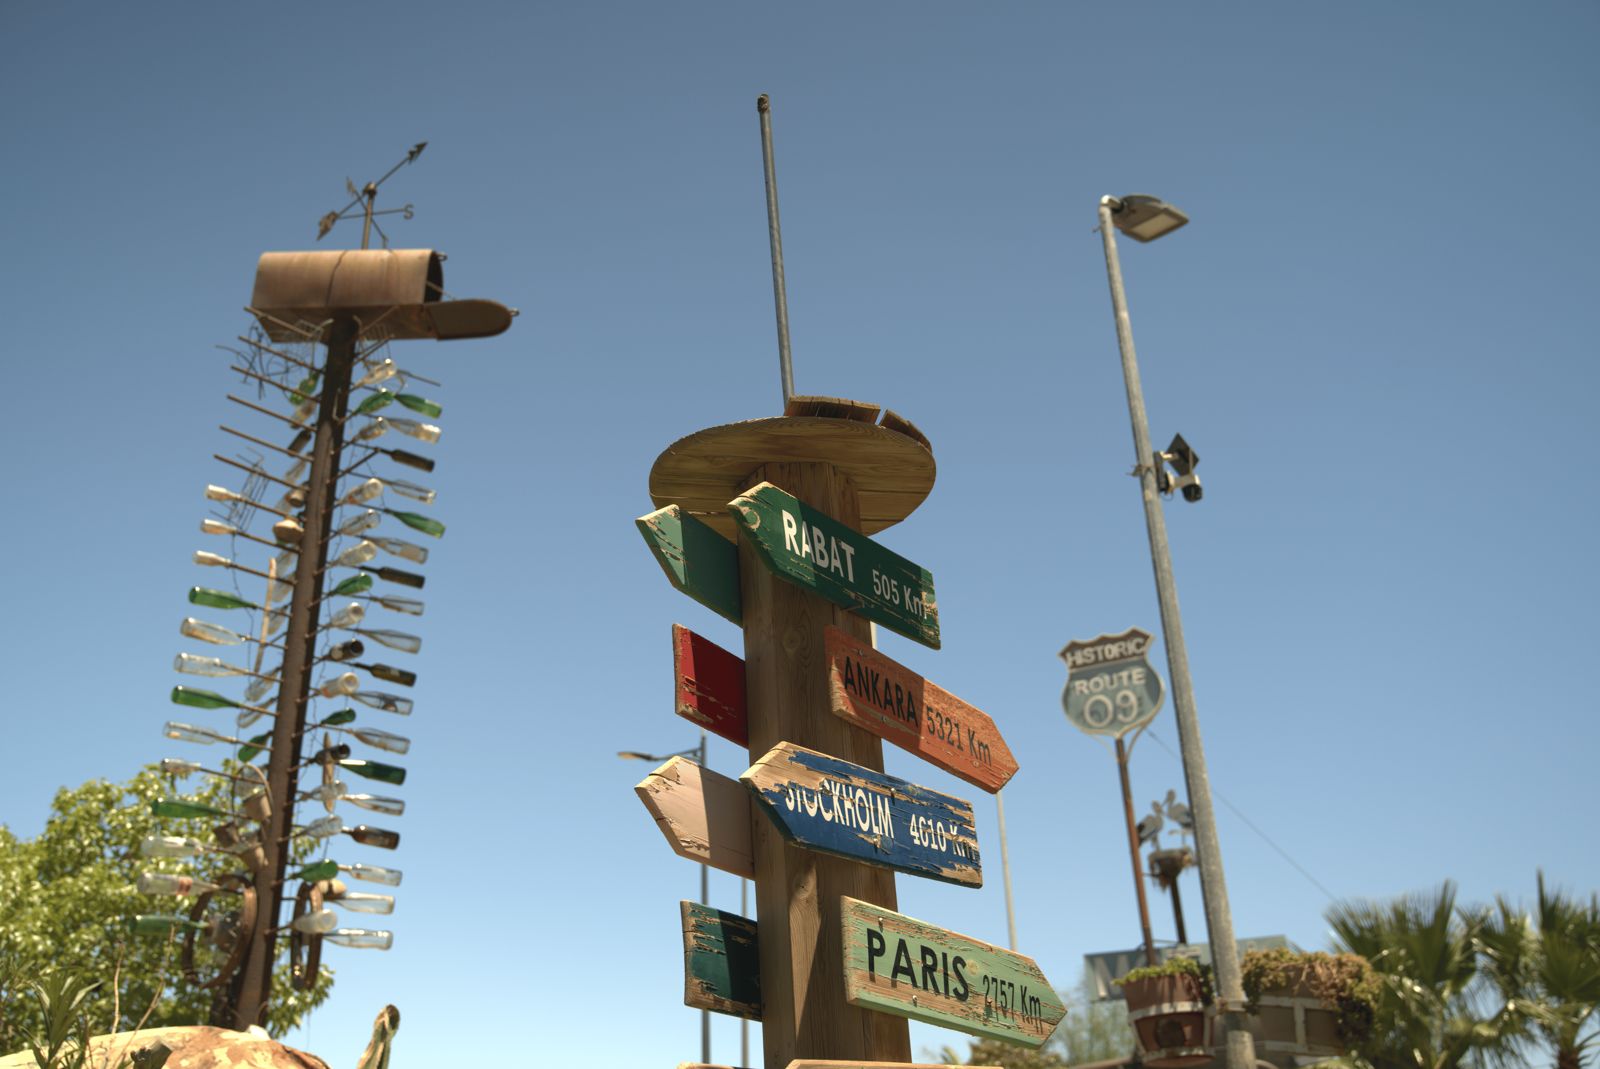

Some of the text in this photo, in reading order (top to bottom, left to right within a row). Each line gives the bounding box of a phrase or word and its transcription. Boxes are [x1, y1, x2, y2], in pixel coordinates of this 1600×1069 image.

[781, 509, 855, 583] RABAT
[872, 568, 900, 605] 505
[1065, 637, 1146, 668] HISTORIC
[1074, 667, 1147, 697] ROUTE
[844, 655, 992, 767] ANKARA 5321 Km
[1083, 690, 1139, 728] 09
[866, 927, 1044, 1036] PARIS 2757 Km
